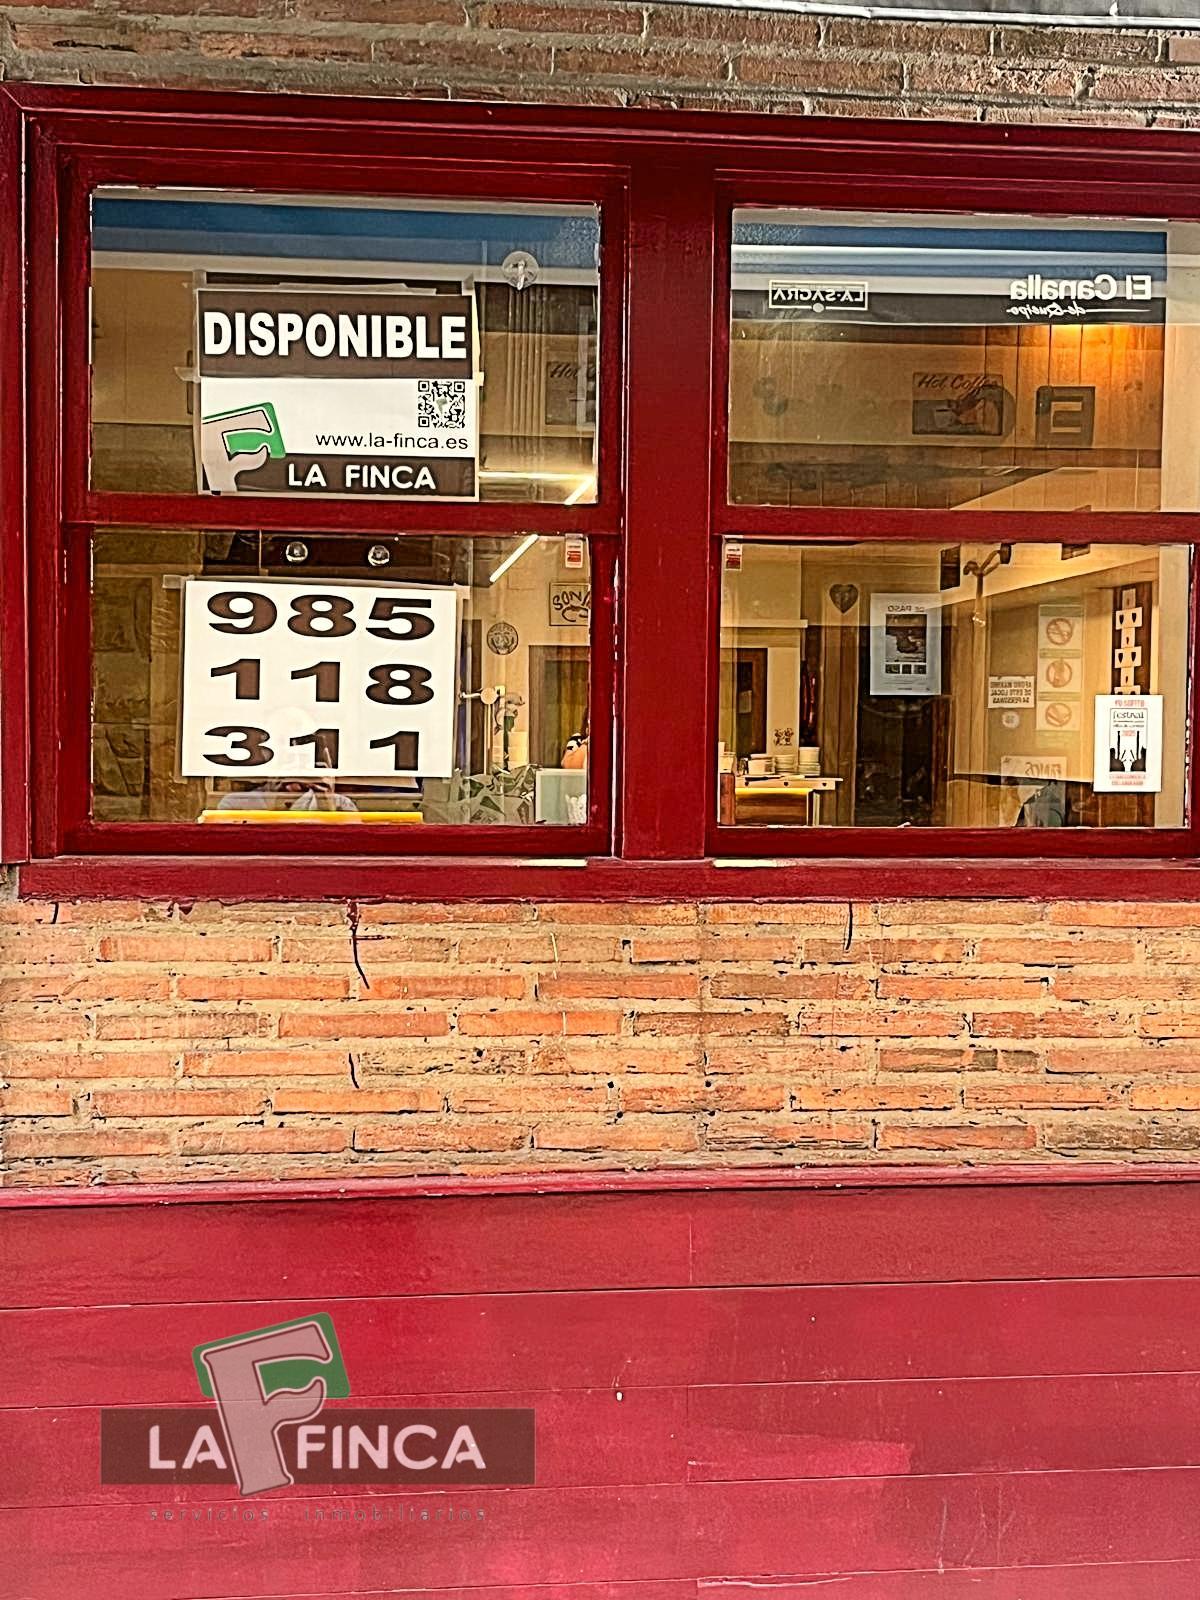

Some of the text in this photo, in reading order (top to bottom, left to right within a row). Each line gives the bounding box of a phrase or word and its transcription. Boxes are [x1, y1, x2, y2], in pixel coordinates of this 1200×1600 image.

[203, 312, 467, 360] DISPONIBLE
[315, 431, 469, 451] www.la-finca.es
[287, 463, 436, 491] LA FINCA
[206, 591, 436, 641] 985
[209, 657, 436, 706] 118
[202, 725, 421, 772] 311
